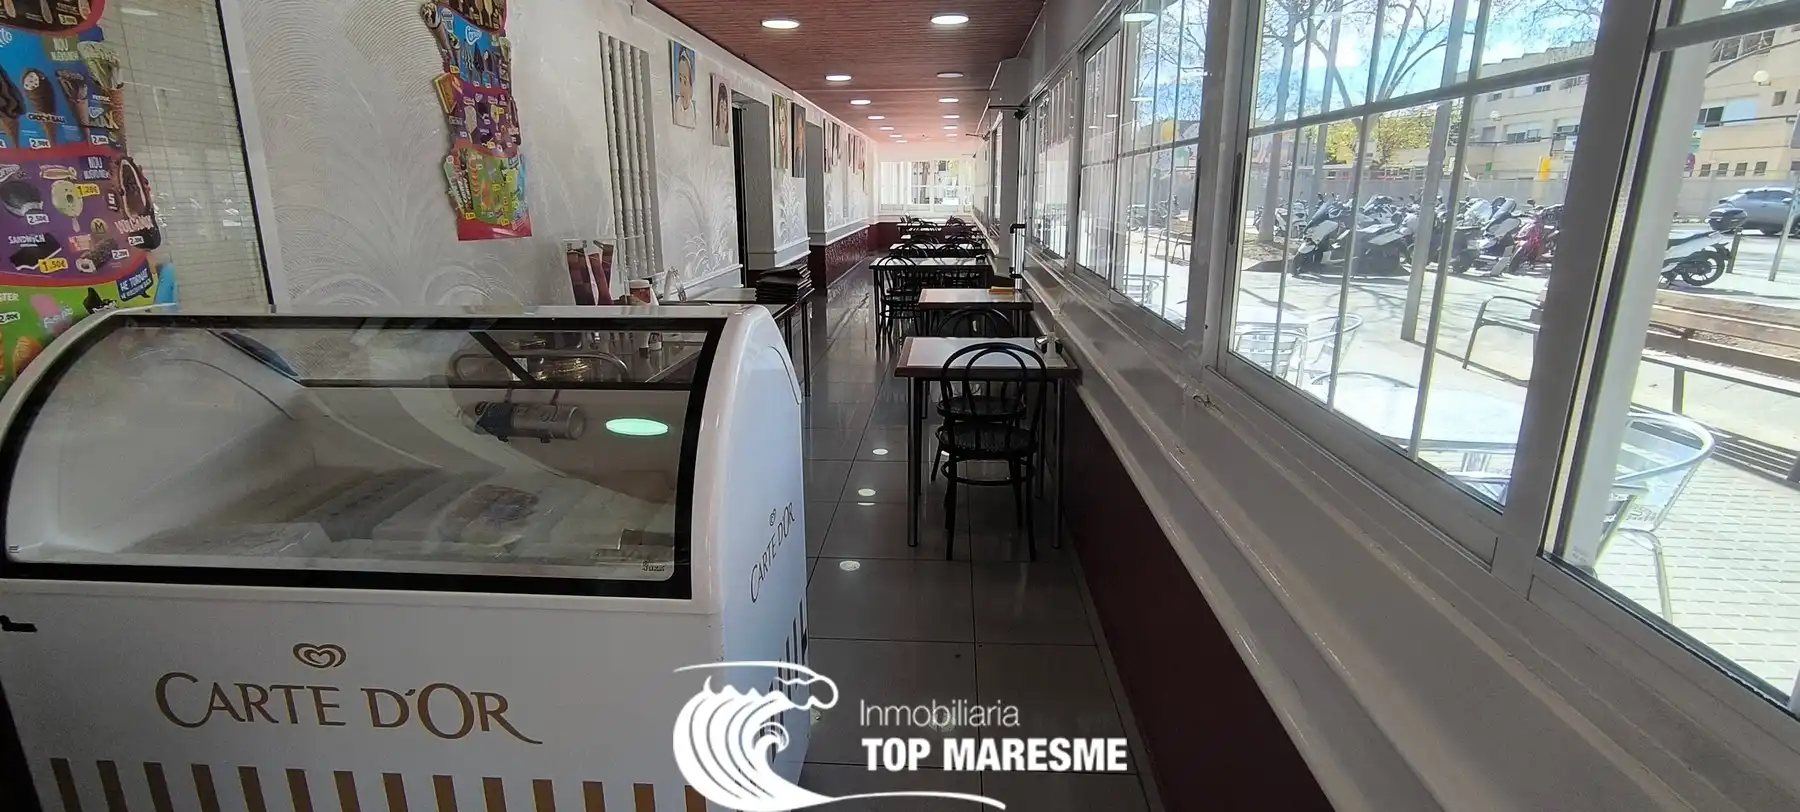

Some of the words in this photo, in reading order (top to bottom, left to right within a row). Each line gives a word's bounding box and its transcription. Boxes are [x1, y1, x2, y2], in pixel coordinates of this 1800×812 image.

[8, 233, 46, 245] SANDWICH
[154, 671, 347, 729] CARTE
[360, 682, 544, 745] D'OR
